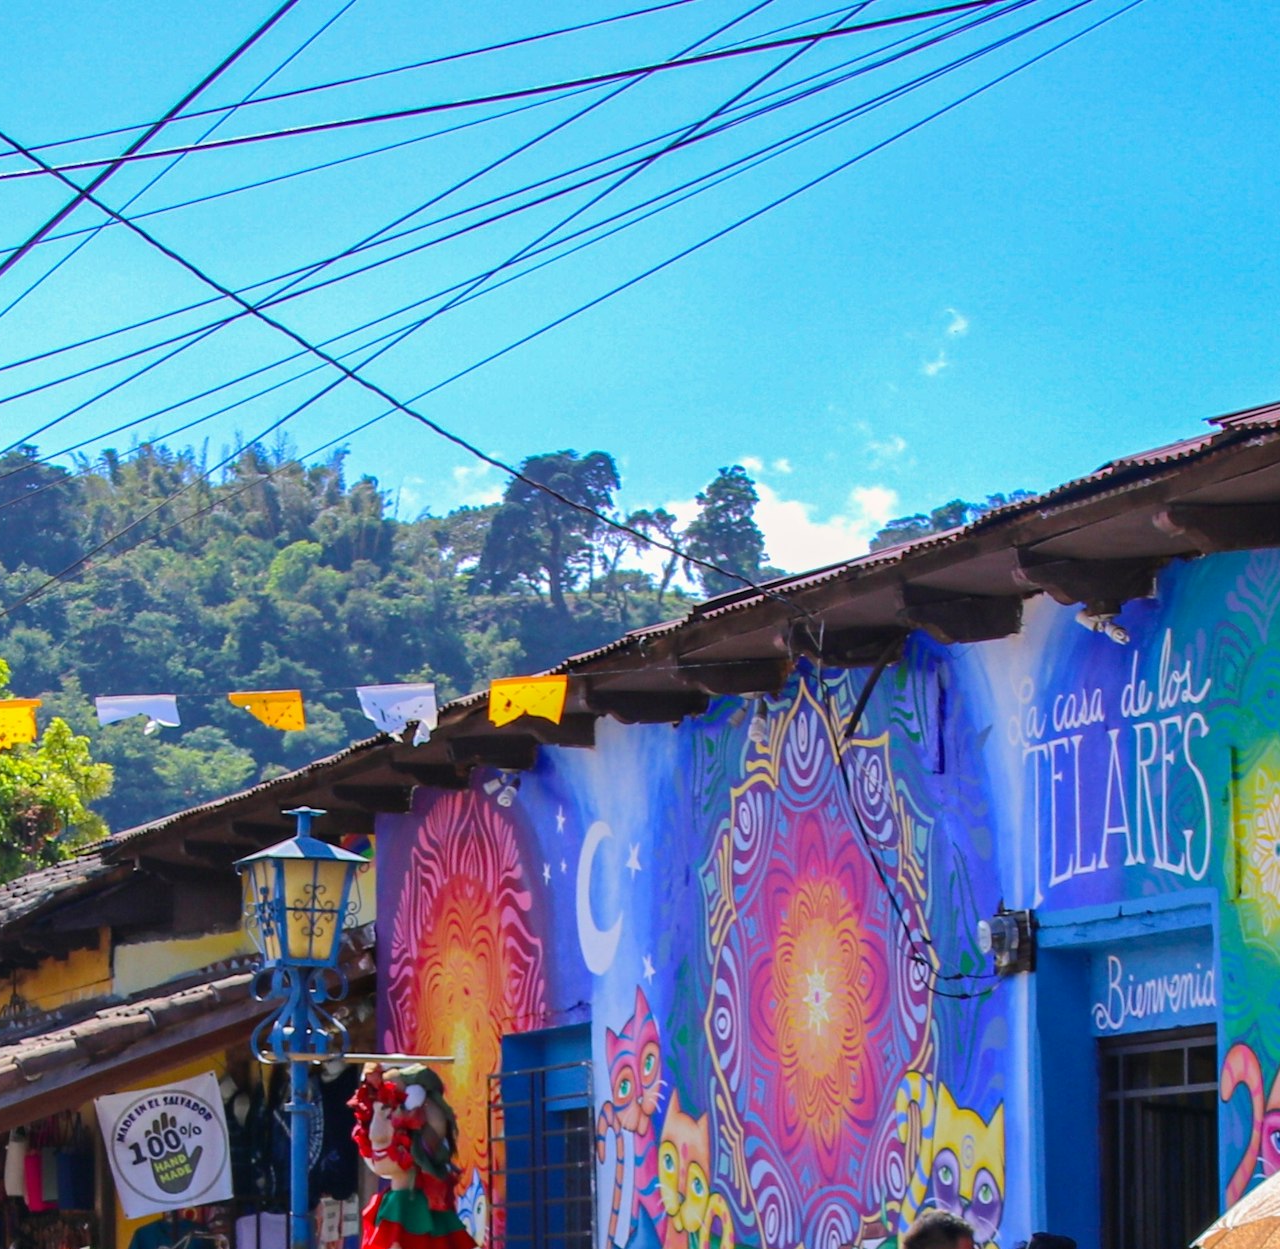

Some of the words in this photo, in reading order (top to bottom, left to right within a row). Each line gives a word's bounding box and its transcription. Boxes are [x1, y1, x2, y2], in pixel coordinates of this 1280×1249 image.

[1052, 688, 1105, 732] casa
[1121, 650, 1153, 718] de
[1158, 628, 1211, 709] los
[1022, 712, 1212, 907] TELARES
[117, 1113, 136, 1143] MADE
[134, 1103, 147, 1116] IN
[147, 1098, 160, 1109] EL
[163, 1096, 213, 1122] SALVADOR
[128, 1122, 202, 1166] 100%
[154, 1156, 187, 1173] HAND
[159, 1166, 193, 1184] MADE
